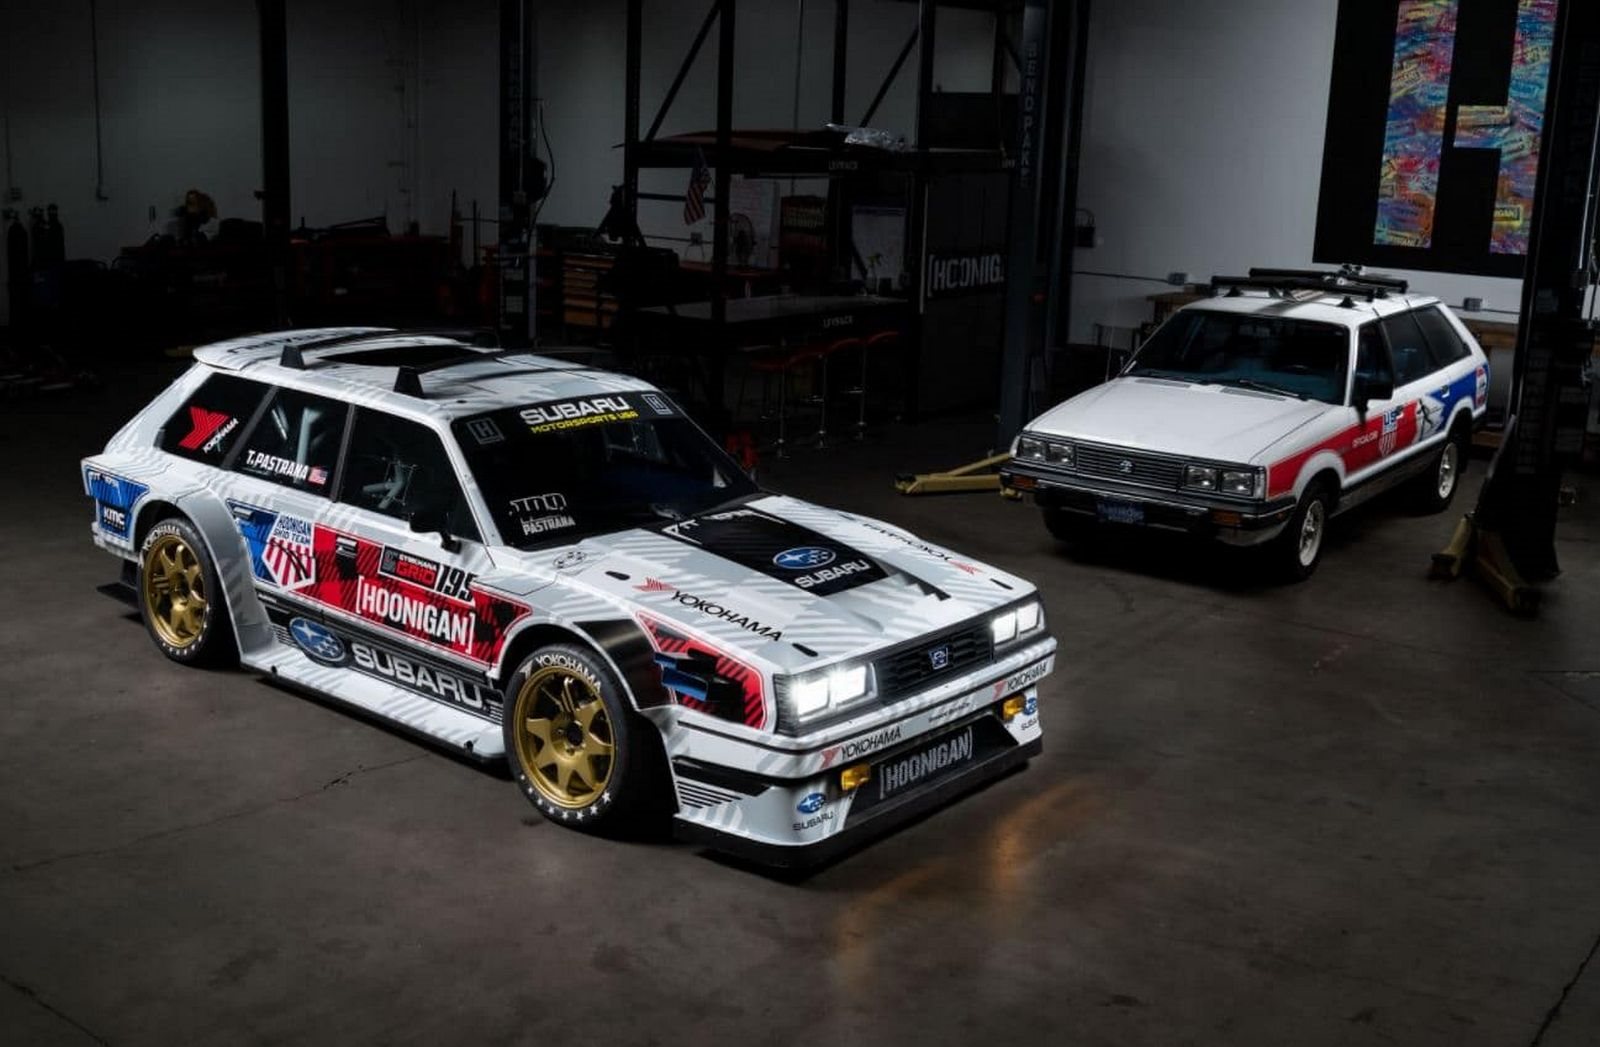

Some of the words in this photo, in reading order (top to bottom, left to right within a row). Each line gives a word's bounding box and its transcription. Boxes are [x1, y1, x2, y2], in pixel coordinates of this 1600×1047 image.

[927, 253, 1006, 299] [HOONIG
[519, 396, 631, 426] SUBARU
[530, 414, 617, 434] MOTORSPORTS
[617, 410, 639, 421] USA
[202, 417, 240, 454] YOKOHAMA
[246, 450, 309, 480] T.PASTRANA
[103, 506, 126, 525] KMC
[277, 514, 312, 536] HOONIGAN
[521, 514, 577, 537] PASTRANA
[272, 529, 291, 540] SKID
[291, 532, 312, 545] TEAM
[396, 560, 436, 585] GRID
[436, 565, 479, 602] 195
[794, 558, 871, 589] SUBARU
[670, 589, 784, 643] YOKOHAMA
[351, 641, 485, 710] SUBARU
[535, 654, 602, 694] YOKOHAMA
[1007, 661, 1048, 692] YOKOHAMA
[841, 726, 903, 761] YOKOHAMA
[792, 811, 835, 832] SUBARU
